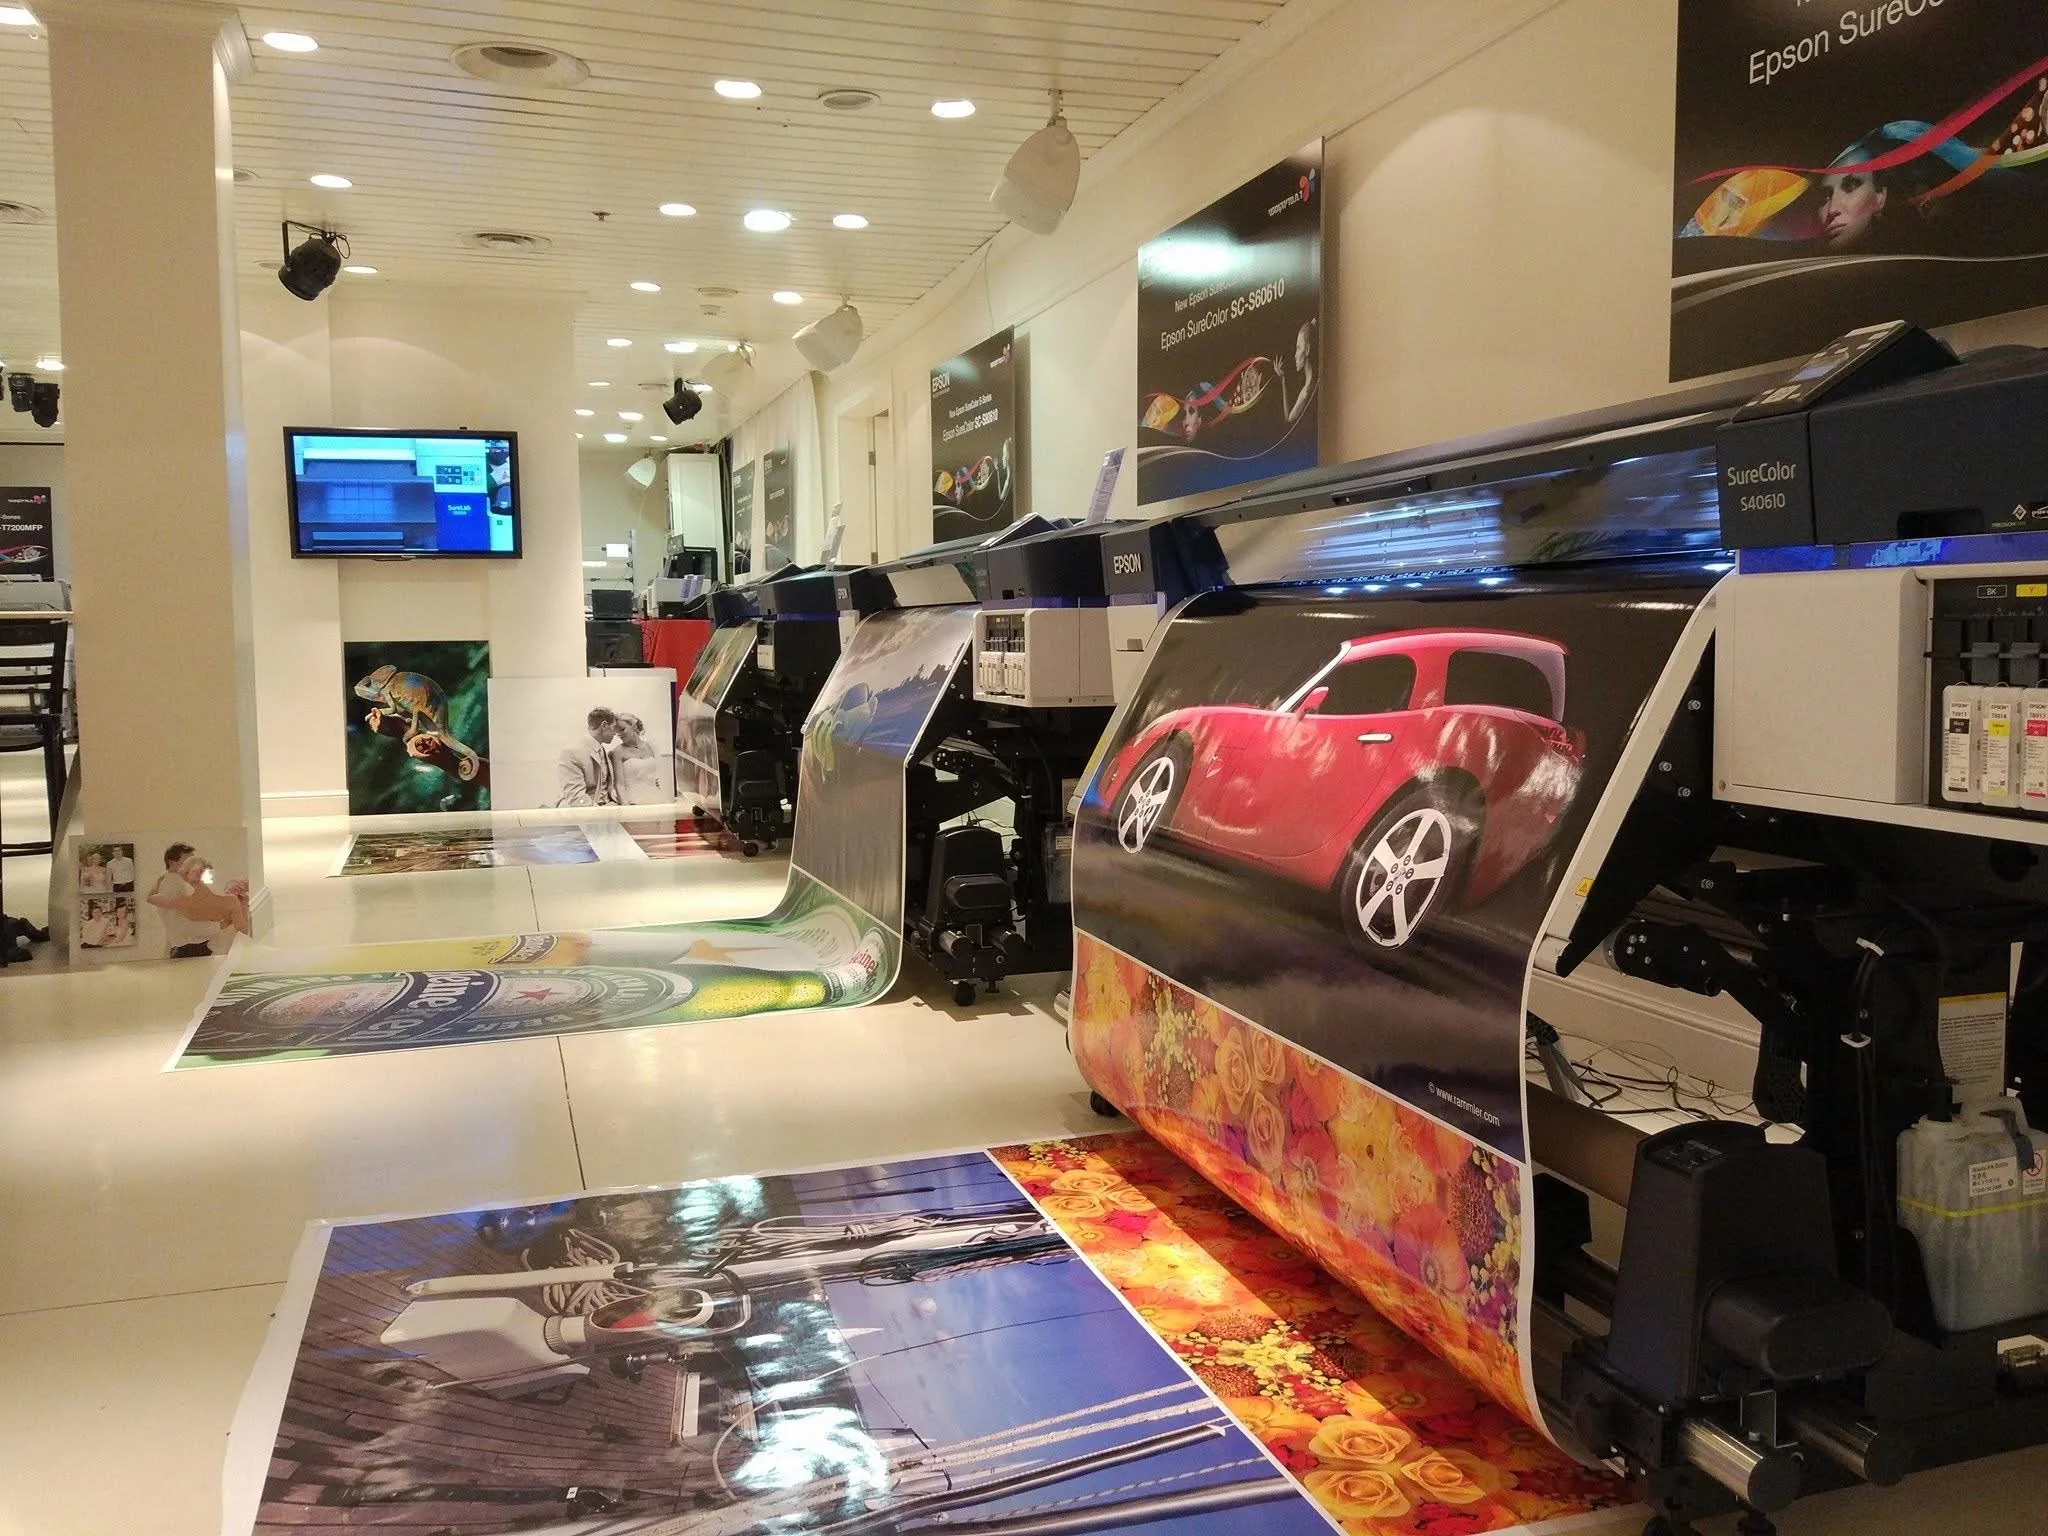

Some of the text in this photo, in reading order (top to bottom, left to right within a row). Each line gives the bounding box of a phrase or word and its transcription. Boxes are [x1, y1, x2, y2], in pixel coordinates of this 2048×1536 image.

[1749, 0, 1944, 85] Epson SureC
[1174, 299, 1187, 313] New
[1189, 290, 1209, 308] Epson
[1160, 278, 1285, 352] Epson SureColor SC-S60610
[1726, 461, 1797, 489] SureColor
[1740, 492, 1786, 512] S40610
[1113, 552, 1142, 575] EPSON
